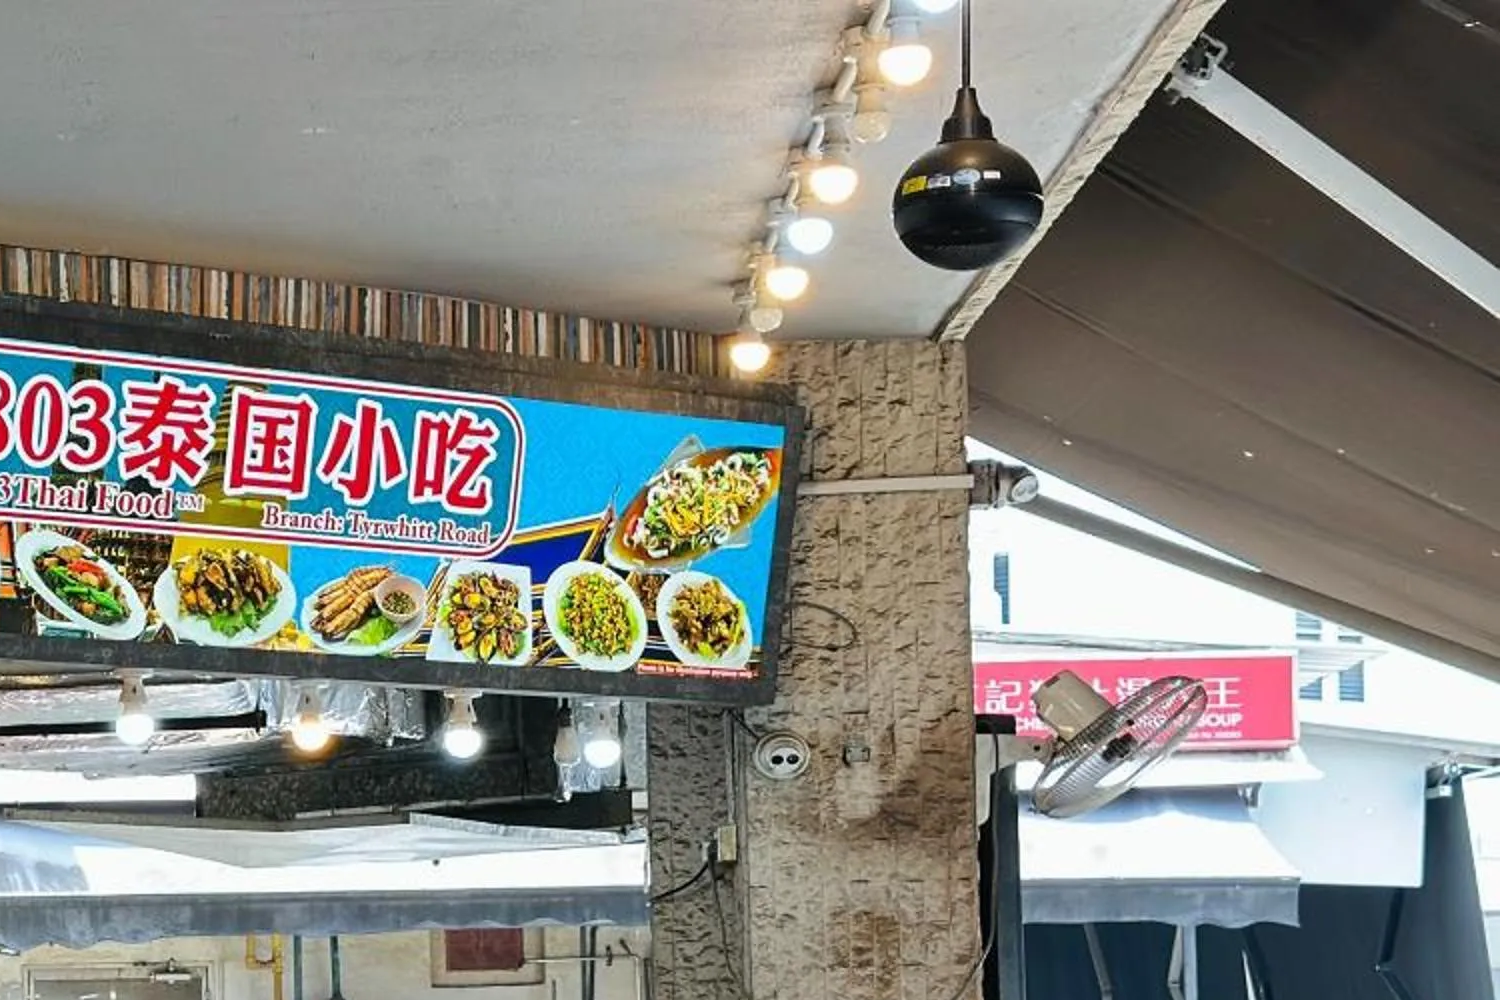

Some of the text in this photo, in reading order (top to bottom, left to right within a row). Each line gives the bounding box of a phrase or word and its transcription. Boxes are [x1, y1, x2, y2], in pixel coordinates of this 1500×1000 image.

[92, 482, 174, 519] Food
[263, 503, 490, 546] Branch: Tyrwhitt Road
